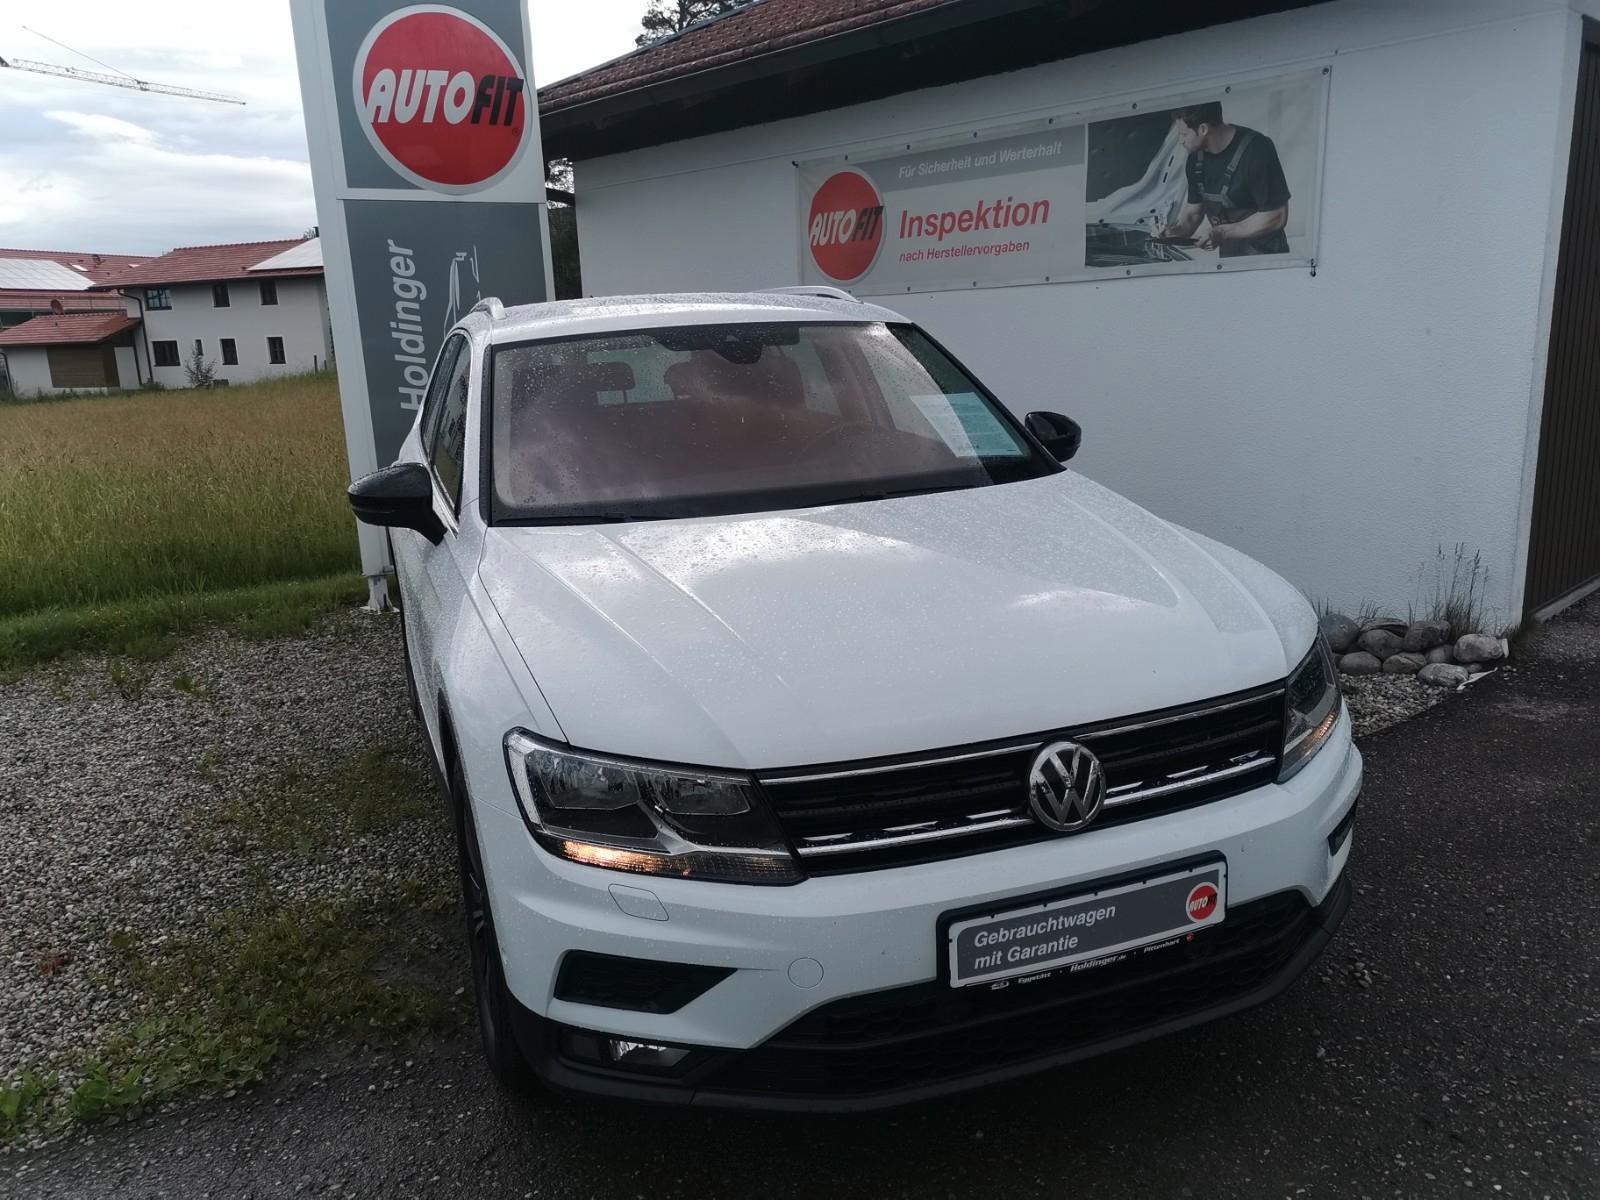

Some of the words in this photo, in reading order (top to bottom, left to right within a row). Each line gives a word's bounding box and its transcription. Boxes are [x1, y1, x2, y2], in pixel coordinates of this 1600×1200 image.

[366, 67, 525, 127] AUTOFIT
[898, 163, 916, 178] Für
[918, 156, 971, 176] Sicherheit
[974, 150, 996, 167] und
[999, 141, 1063, 162] Werterhalt
[808, 205, 884, 246] AUTOFIT
[899, 196, 1050, 242] Inspektion
[899, 250, 925, 262] nach
[926, 239, 1030, 260] Herstellervorgaben
[387, 238, 429, 411] Holdinger
[973, 905, 1116, 948] Gebrauchtwagen
[973, 949, 1002, 970] mit
[1007, 934, 1079, 962] Garantie
